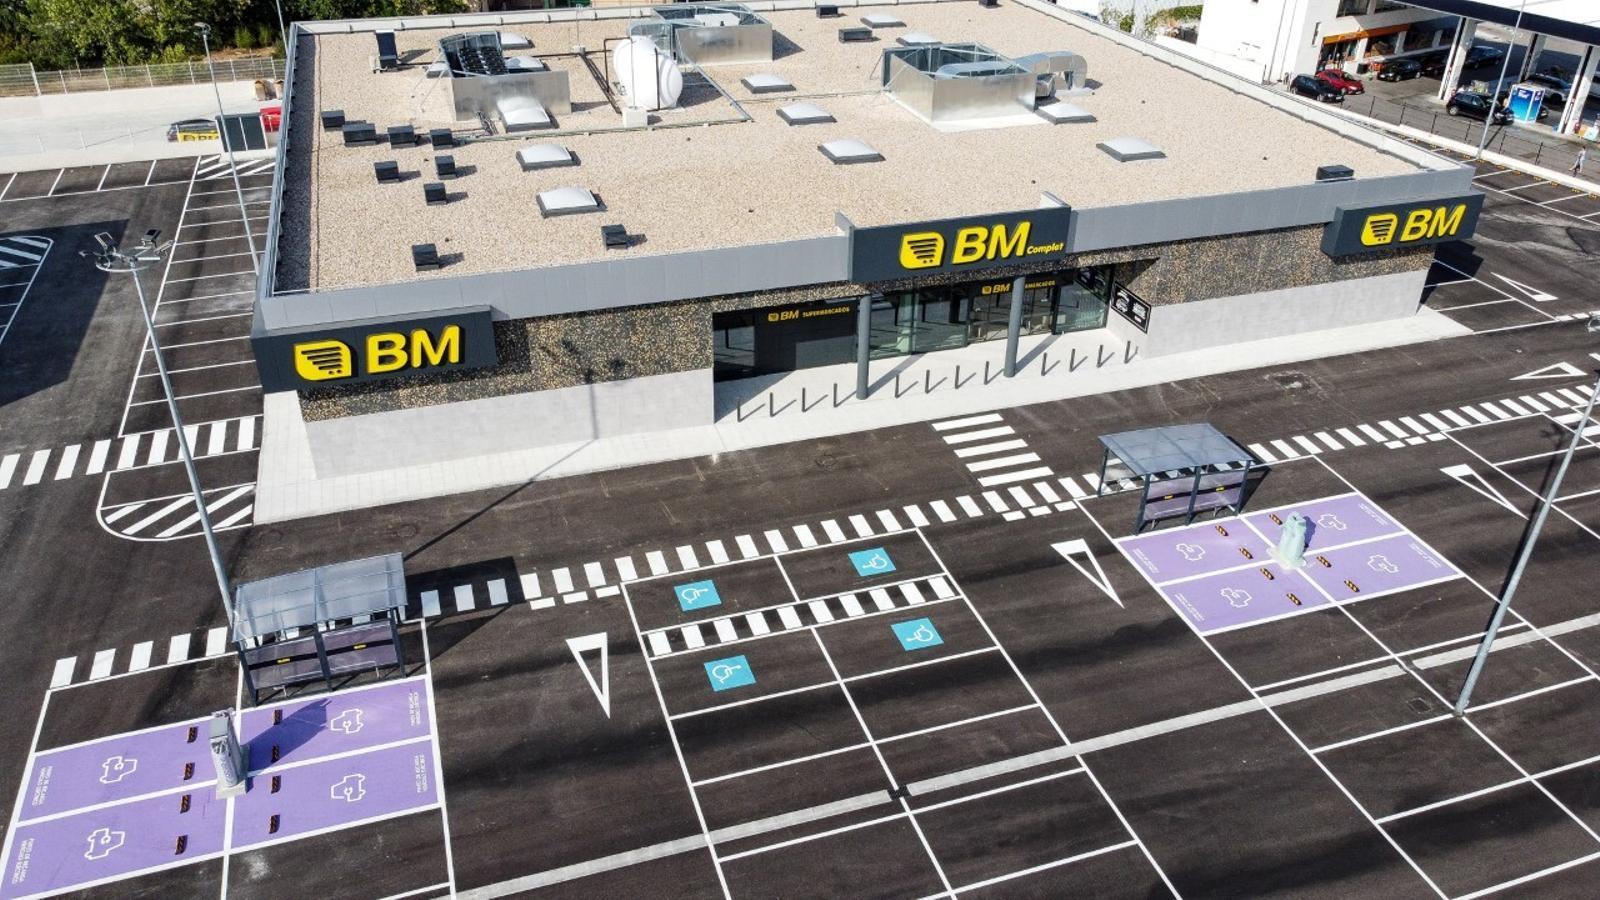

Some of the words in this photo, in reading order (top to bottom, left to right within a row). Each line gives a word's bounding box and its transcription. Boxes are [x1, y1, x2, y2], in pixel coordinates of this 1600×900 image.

[1400, 204, 1467, 242] BM
[952, 221, 1031, 264] BM
[992, 283, 1011, 293] BM
[780, 309, 800, 321] BM
[802, 306, 850, 318] SUPERMERCADOS
[367, 324, 460, 374] BM
